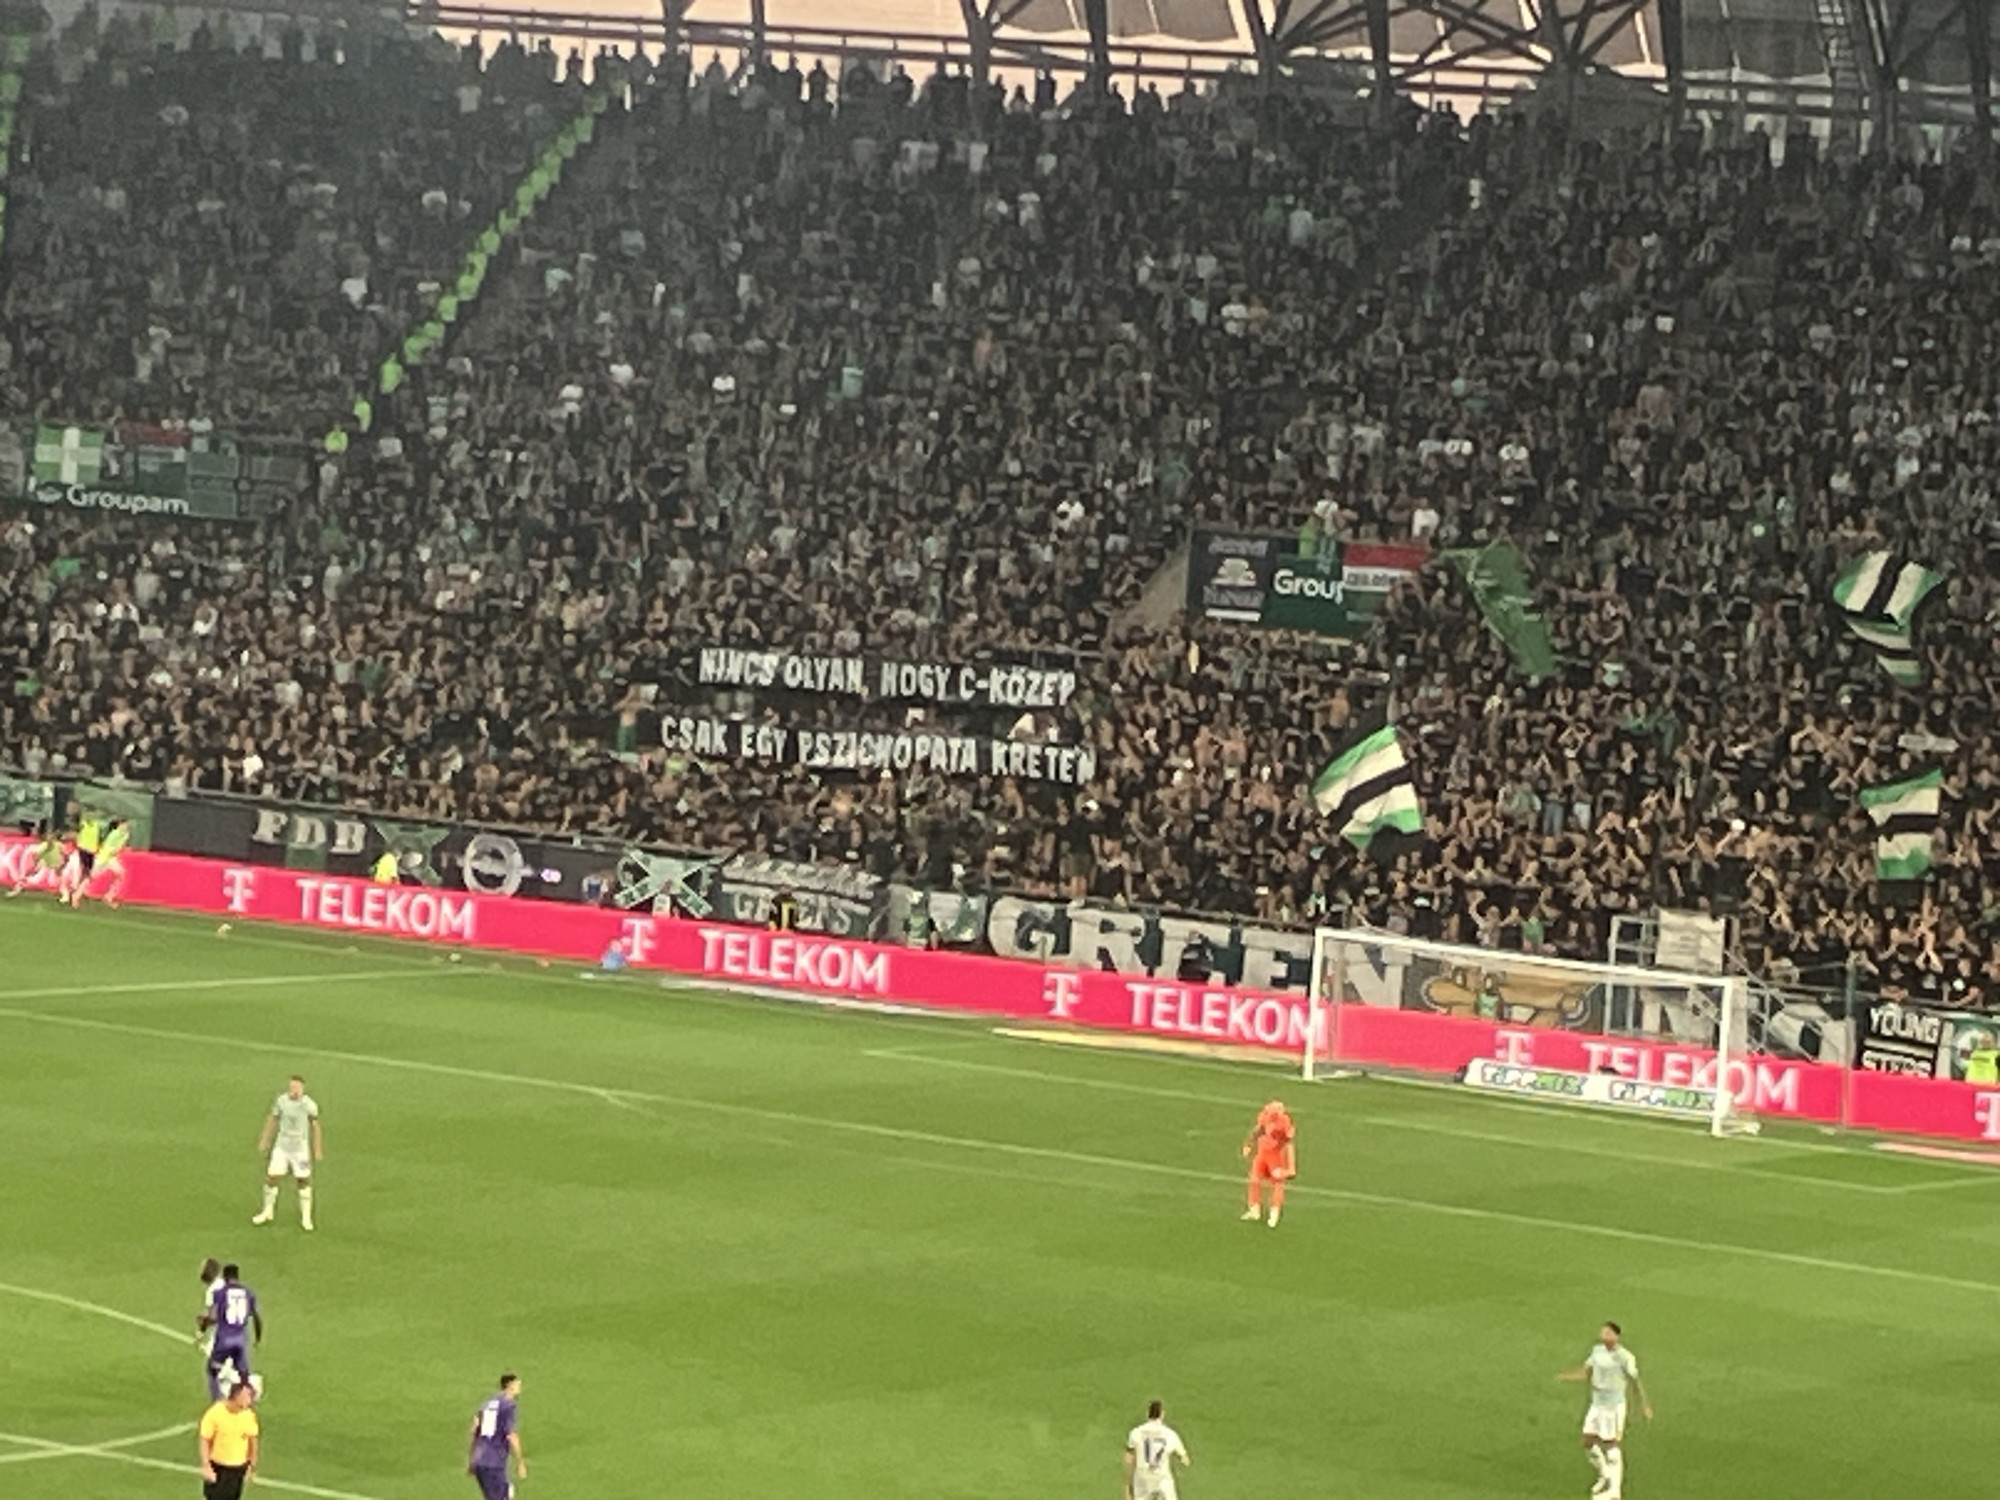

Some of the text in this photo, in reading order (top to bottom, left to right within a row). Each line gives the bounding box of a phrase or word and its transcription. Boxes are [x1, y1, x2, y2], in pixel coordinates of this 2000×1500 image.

[700, 648, 779, 686] NINCS
[881, 662, 951, 701] HOGY
[661, 715, 728, 755] CSAK
[741, 723, 788, 764] EGY
[297, 878, 477, 940] TELEKOM
[699, 928, 890, 994] TELEKOM
[1126, 982, 1328, 1048] TELEKOM
[1870, 1002, 1940, 1044] YOUNG
[1581, 1042, 1798, 1112] TELEKOM
[1143, 1437, 1167, 1464] 17
